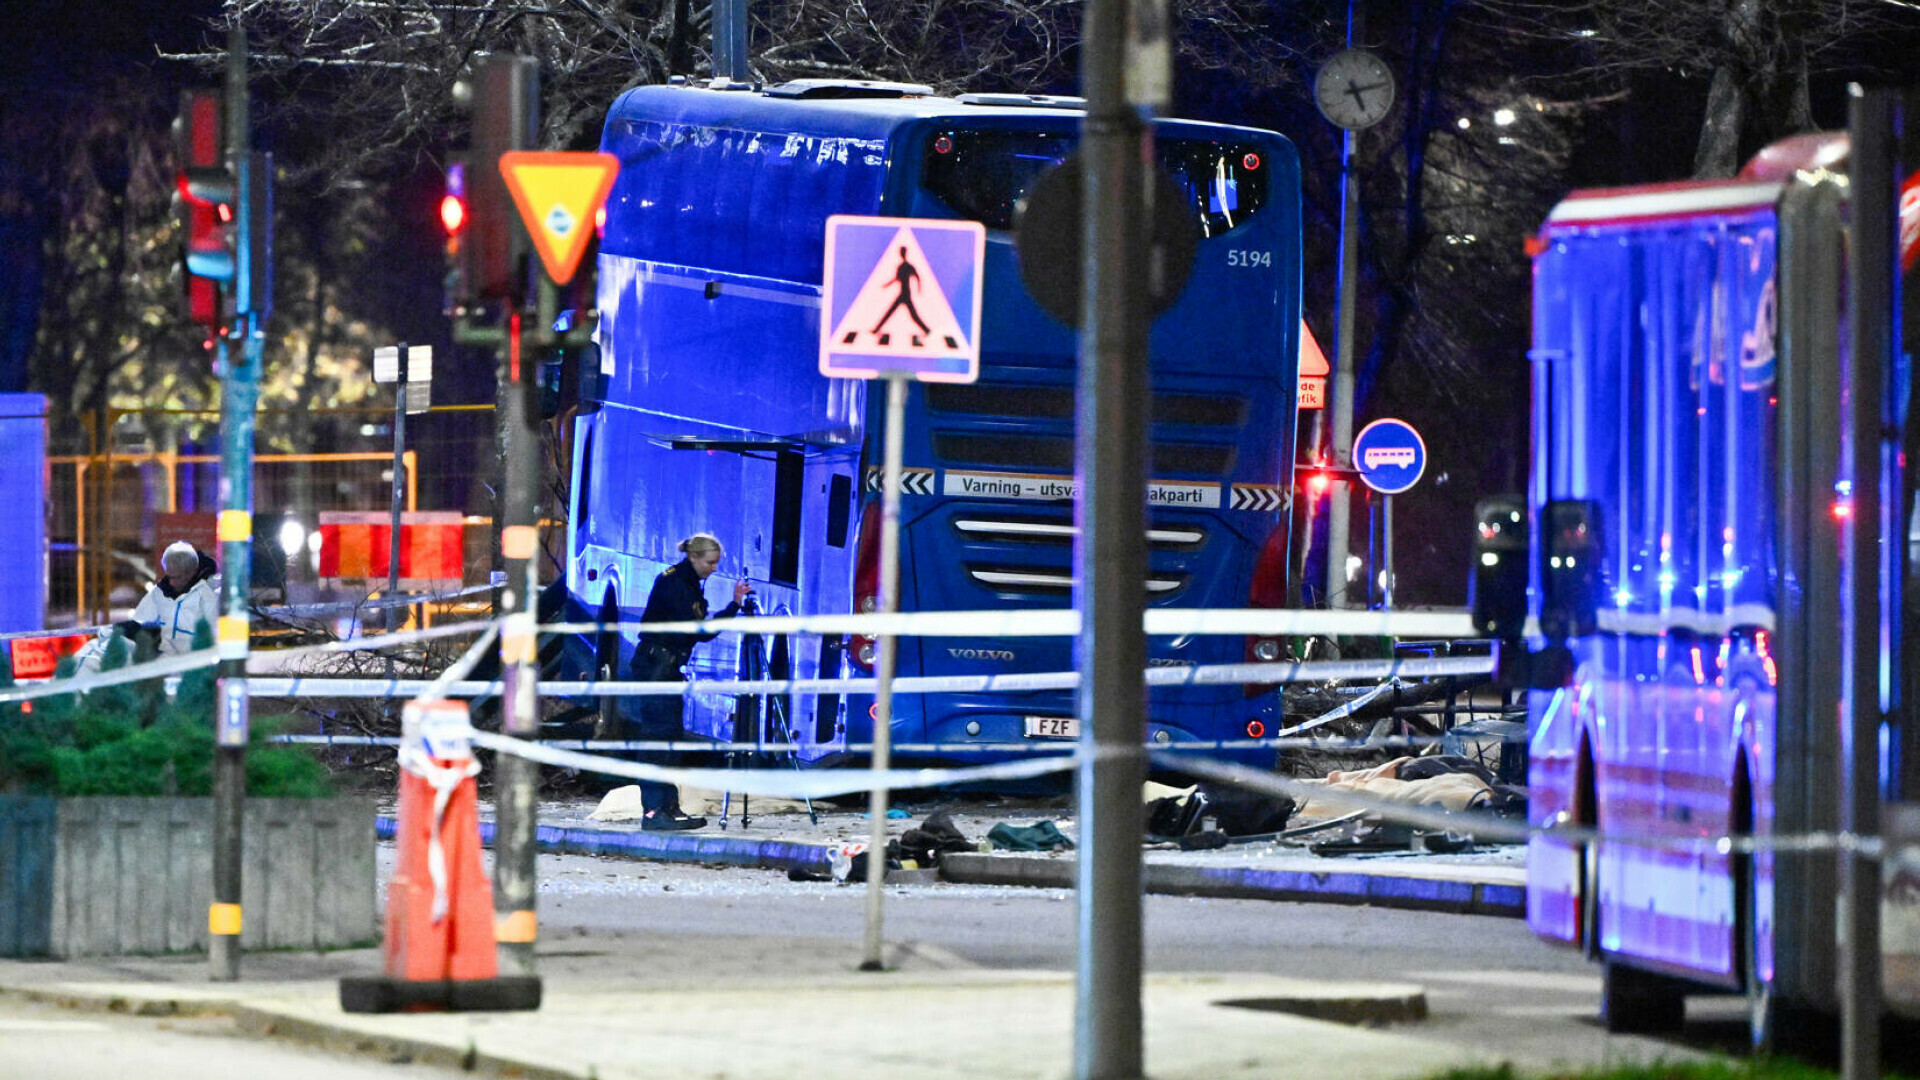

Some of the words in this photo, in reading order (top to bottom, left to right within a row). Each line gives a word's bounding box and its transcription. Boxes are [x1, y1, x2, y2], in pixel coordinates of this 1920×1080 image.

[1227, 249, 1272, 268] 5194
[962, 478, 1020, 497] Varning
[1149, 487, 1203, 504] akparti
[947, 648, 1015, 661] VOLVO
[1039, 719, 1070, 735] FZF
